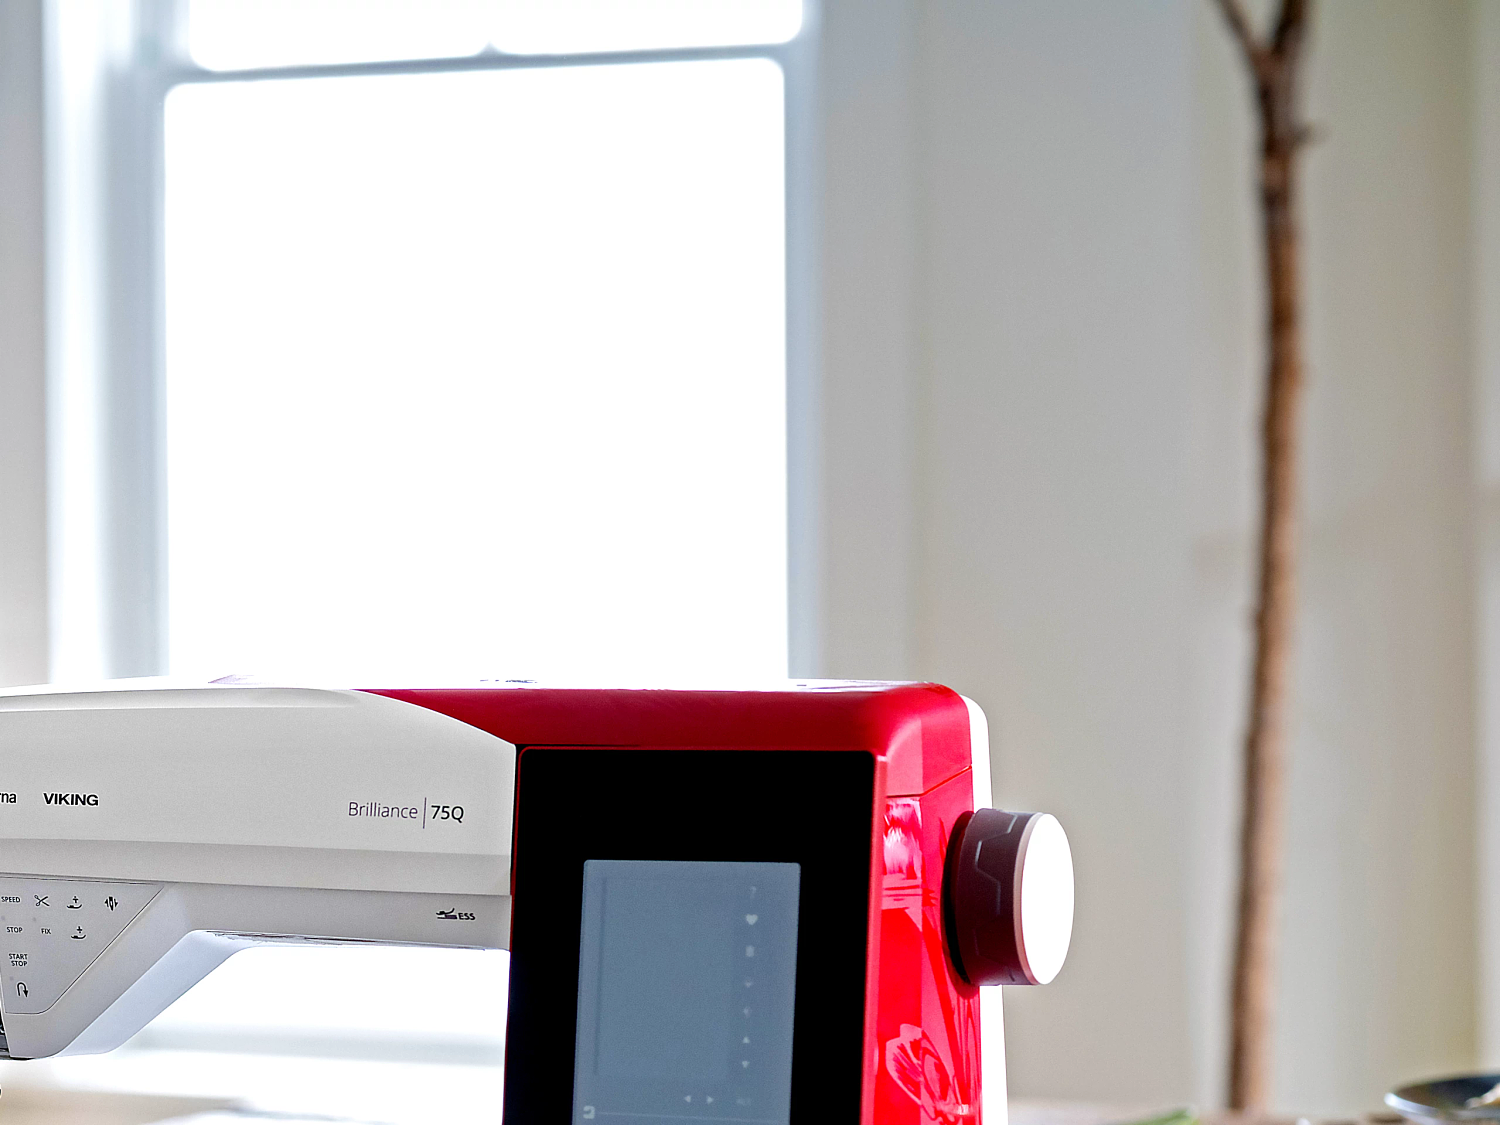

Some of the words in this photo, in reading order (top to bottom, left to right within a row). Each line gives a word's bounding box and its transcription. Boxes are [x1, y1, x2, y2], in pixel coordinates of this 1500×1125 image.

[43, 792, 99, 806] VIKING
[348, 801, 418, 819] Brilliance
[430, 804, 465, 824] 75Q
[458, 912, 476, 921] ESS
[6, 926, 23, 934] STOP
